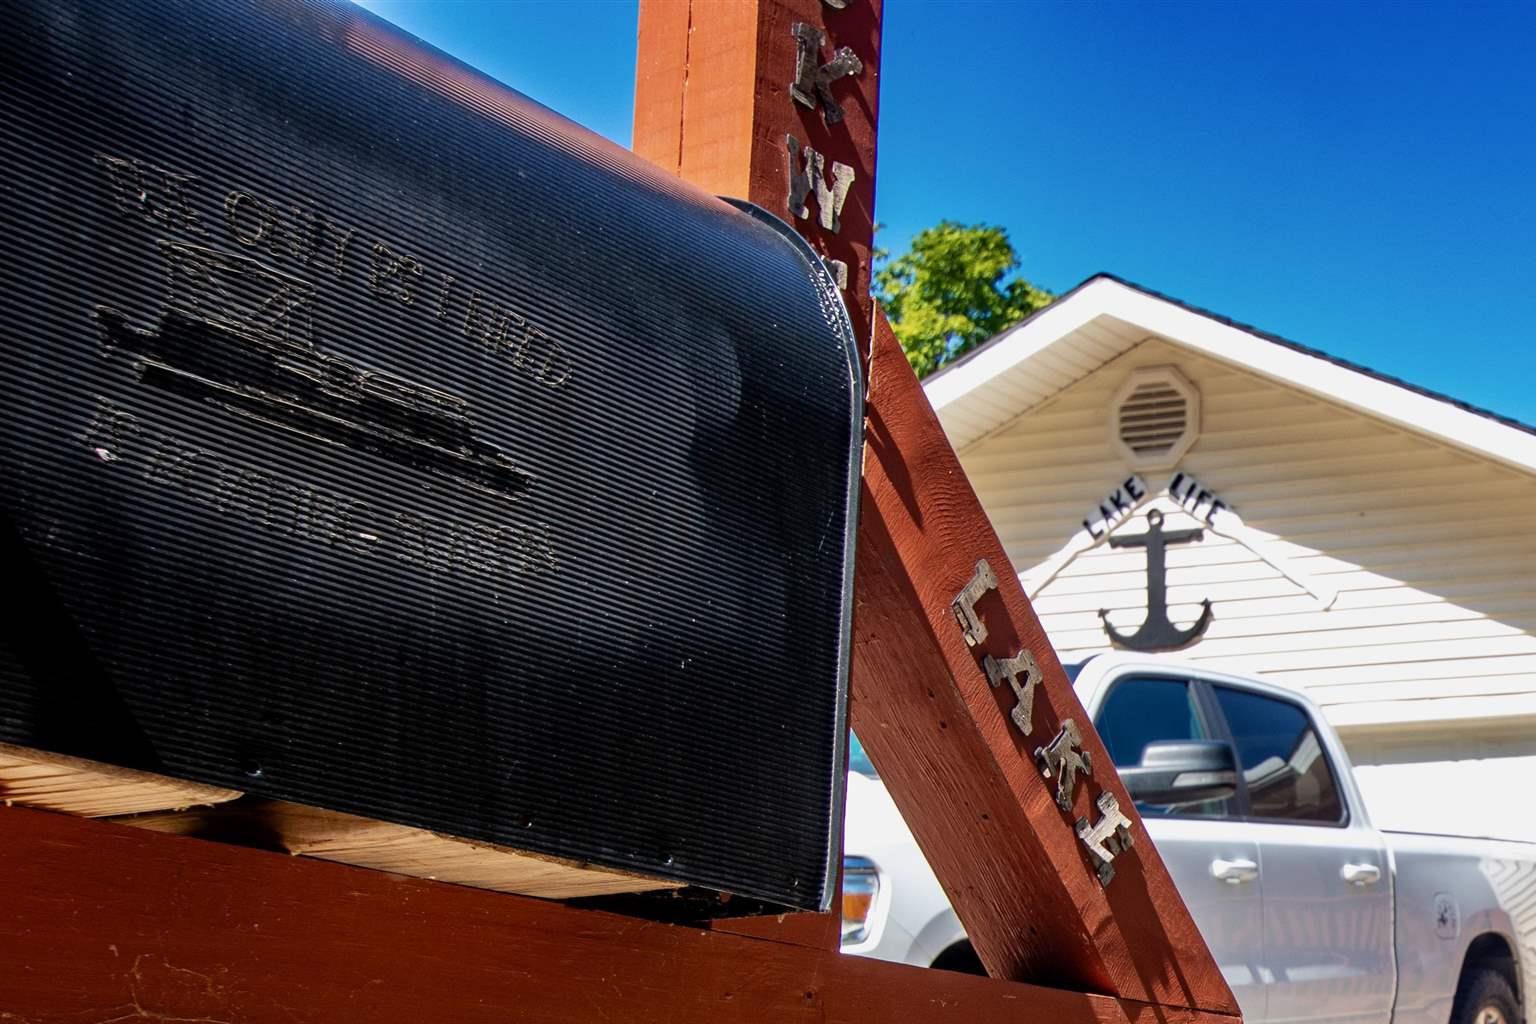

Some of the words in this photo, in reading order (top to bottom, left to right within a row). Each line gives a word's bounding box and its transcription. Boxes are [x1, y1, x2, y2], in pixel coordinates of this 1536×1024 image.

[224, 190, 354, 277] ONLY
[463, 288, 576, 389] NEED
[1083, 476, 1145, 540] LAKE
[1169, 472, 1226, 527] LIFE
[950, 558, 1133, 887] LAKE
